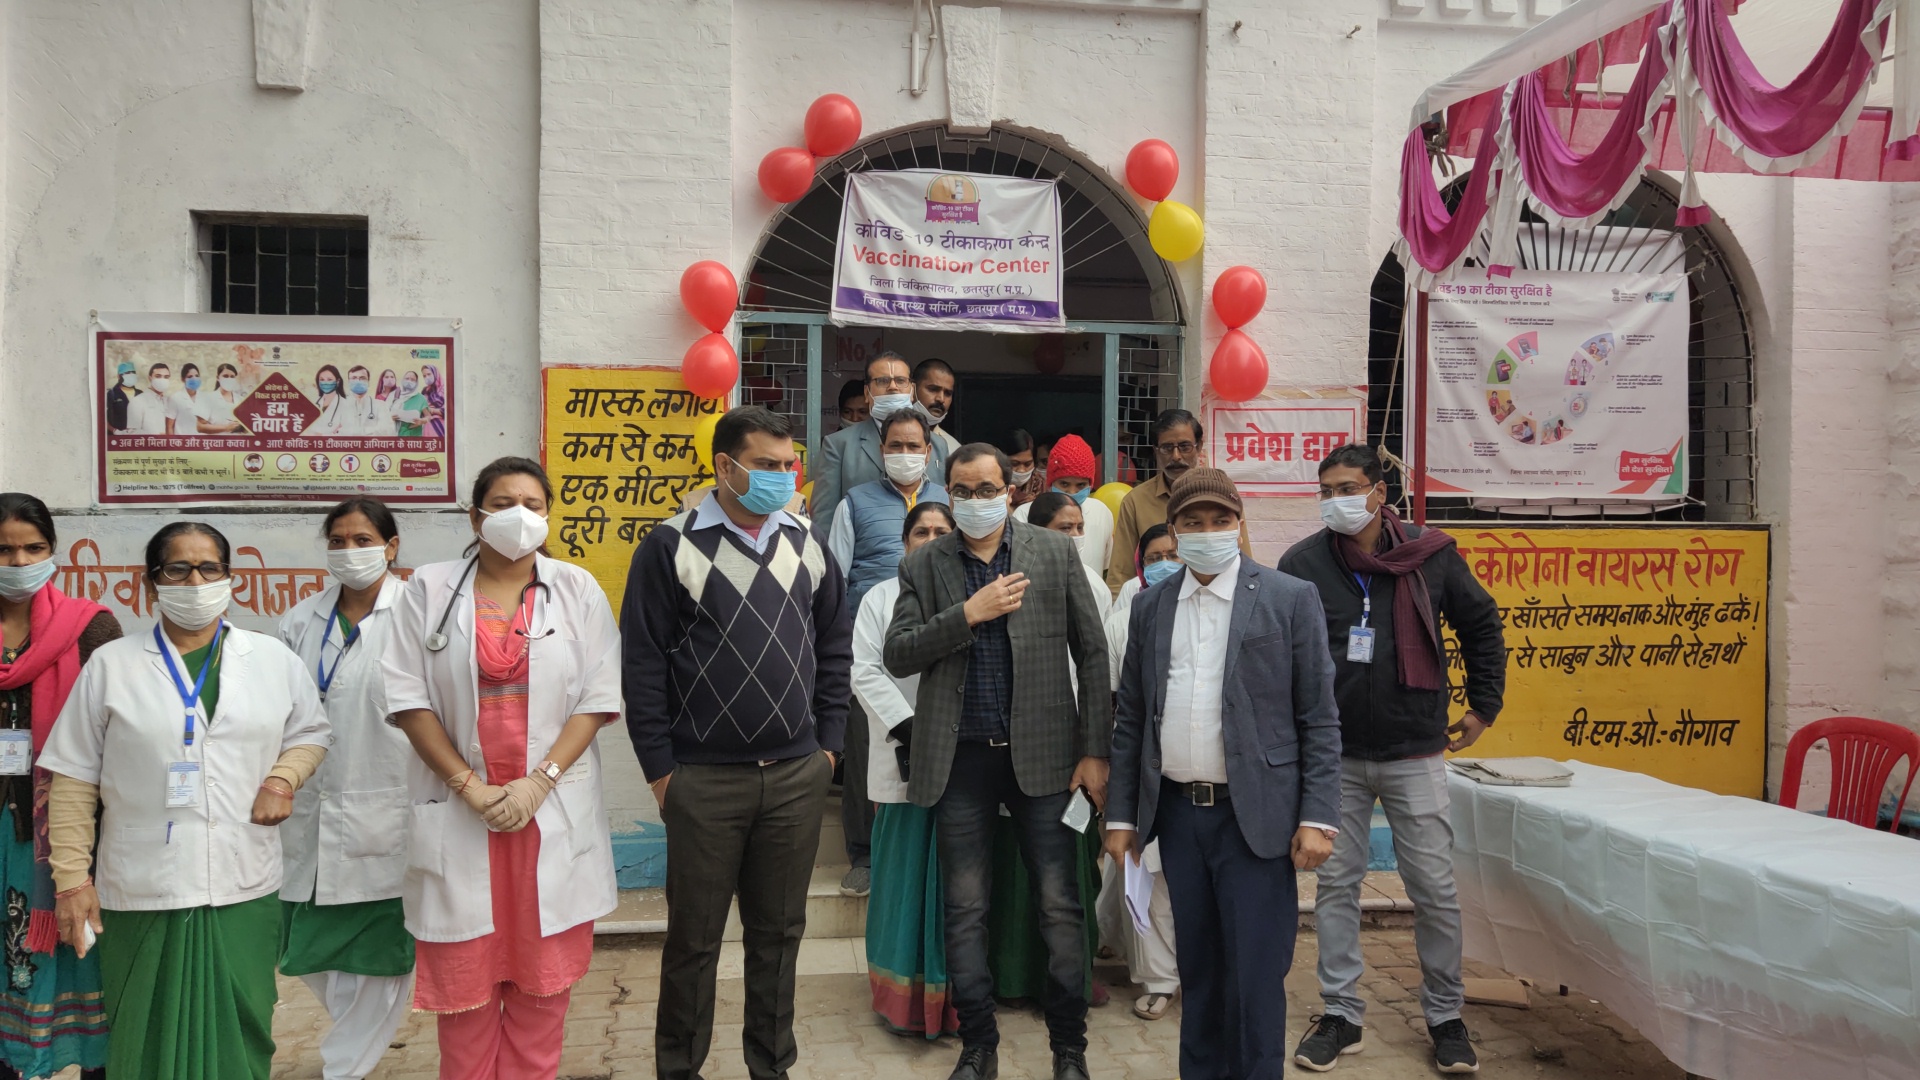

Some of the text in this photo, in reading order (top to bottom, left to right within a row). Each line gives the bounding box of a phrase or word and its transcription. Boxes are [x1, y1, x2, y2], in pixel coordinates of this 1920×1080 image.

[854, 219, 1051, 252] कोविड-19 टीकाकरण केन्द्र
[852, 244, 1051, 275] Vaccination Center
[869, 274, 895, 289] जिला
[897, 276, 958, 296] चिकित्सालय,
[1469, 284, 1482, 295] का
[1484, 283, 1508, 296] टीका
[1510, 283, 1543, 299] सुरक्षित
[1545, 283, 1553, 297] है
[863, 293, 890, 308] जिला
[891, 296, 926, 313] स्वास्थ्य
[929, 300, 962, 315] समिति,
[266, 401, 290, 417] हम
[564, 388, 646, 418] मास्क
[250, 412, 305, 433] तैयार हैं
[119, 438, 132, 448] अब
[148, 437, 167, 448] मिला
[169, 438, 183, 448] एक
[184, 437, 200, 448] और
[202, 438, 224, 450] सुरक्षा
[286, 437, 323, 449] कोविड-19
[326, 438, 362, 449] टीकाकरण
[364, 438, 396, 450] अभियान
[397, 439, 405, 449] के
[406, 440, 422, 450] साथ
[562, 423, 698, 465] कम से कम
[1224, 422, 1295, 464] प्रवेश
[122, 484, 148, 492] Helpline
[560, 474, 609, 505] एक
[613, 464, 690, 506] मीटर
[559, 505, 611, 559] दूरी
[1473, 531, 1745, 593] कोरोना वायरस रोग
[1652, 593, 1686, 627] और
[1516, 635, 1538, 669] से
[1539, 645, 1595, 675] साबुन
[1595, 633, 1636, 668] और
[1639, 632, 1685, 666] पानी
